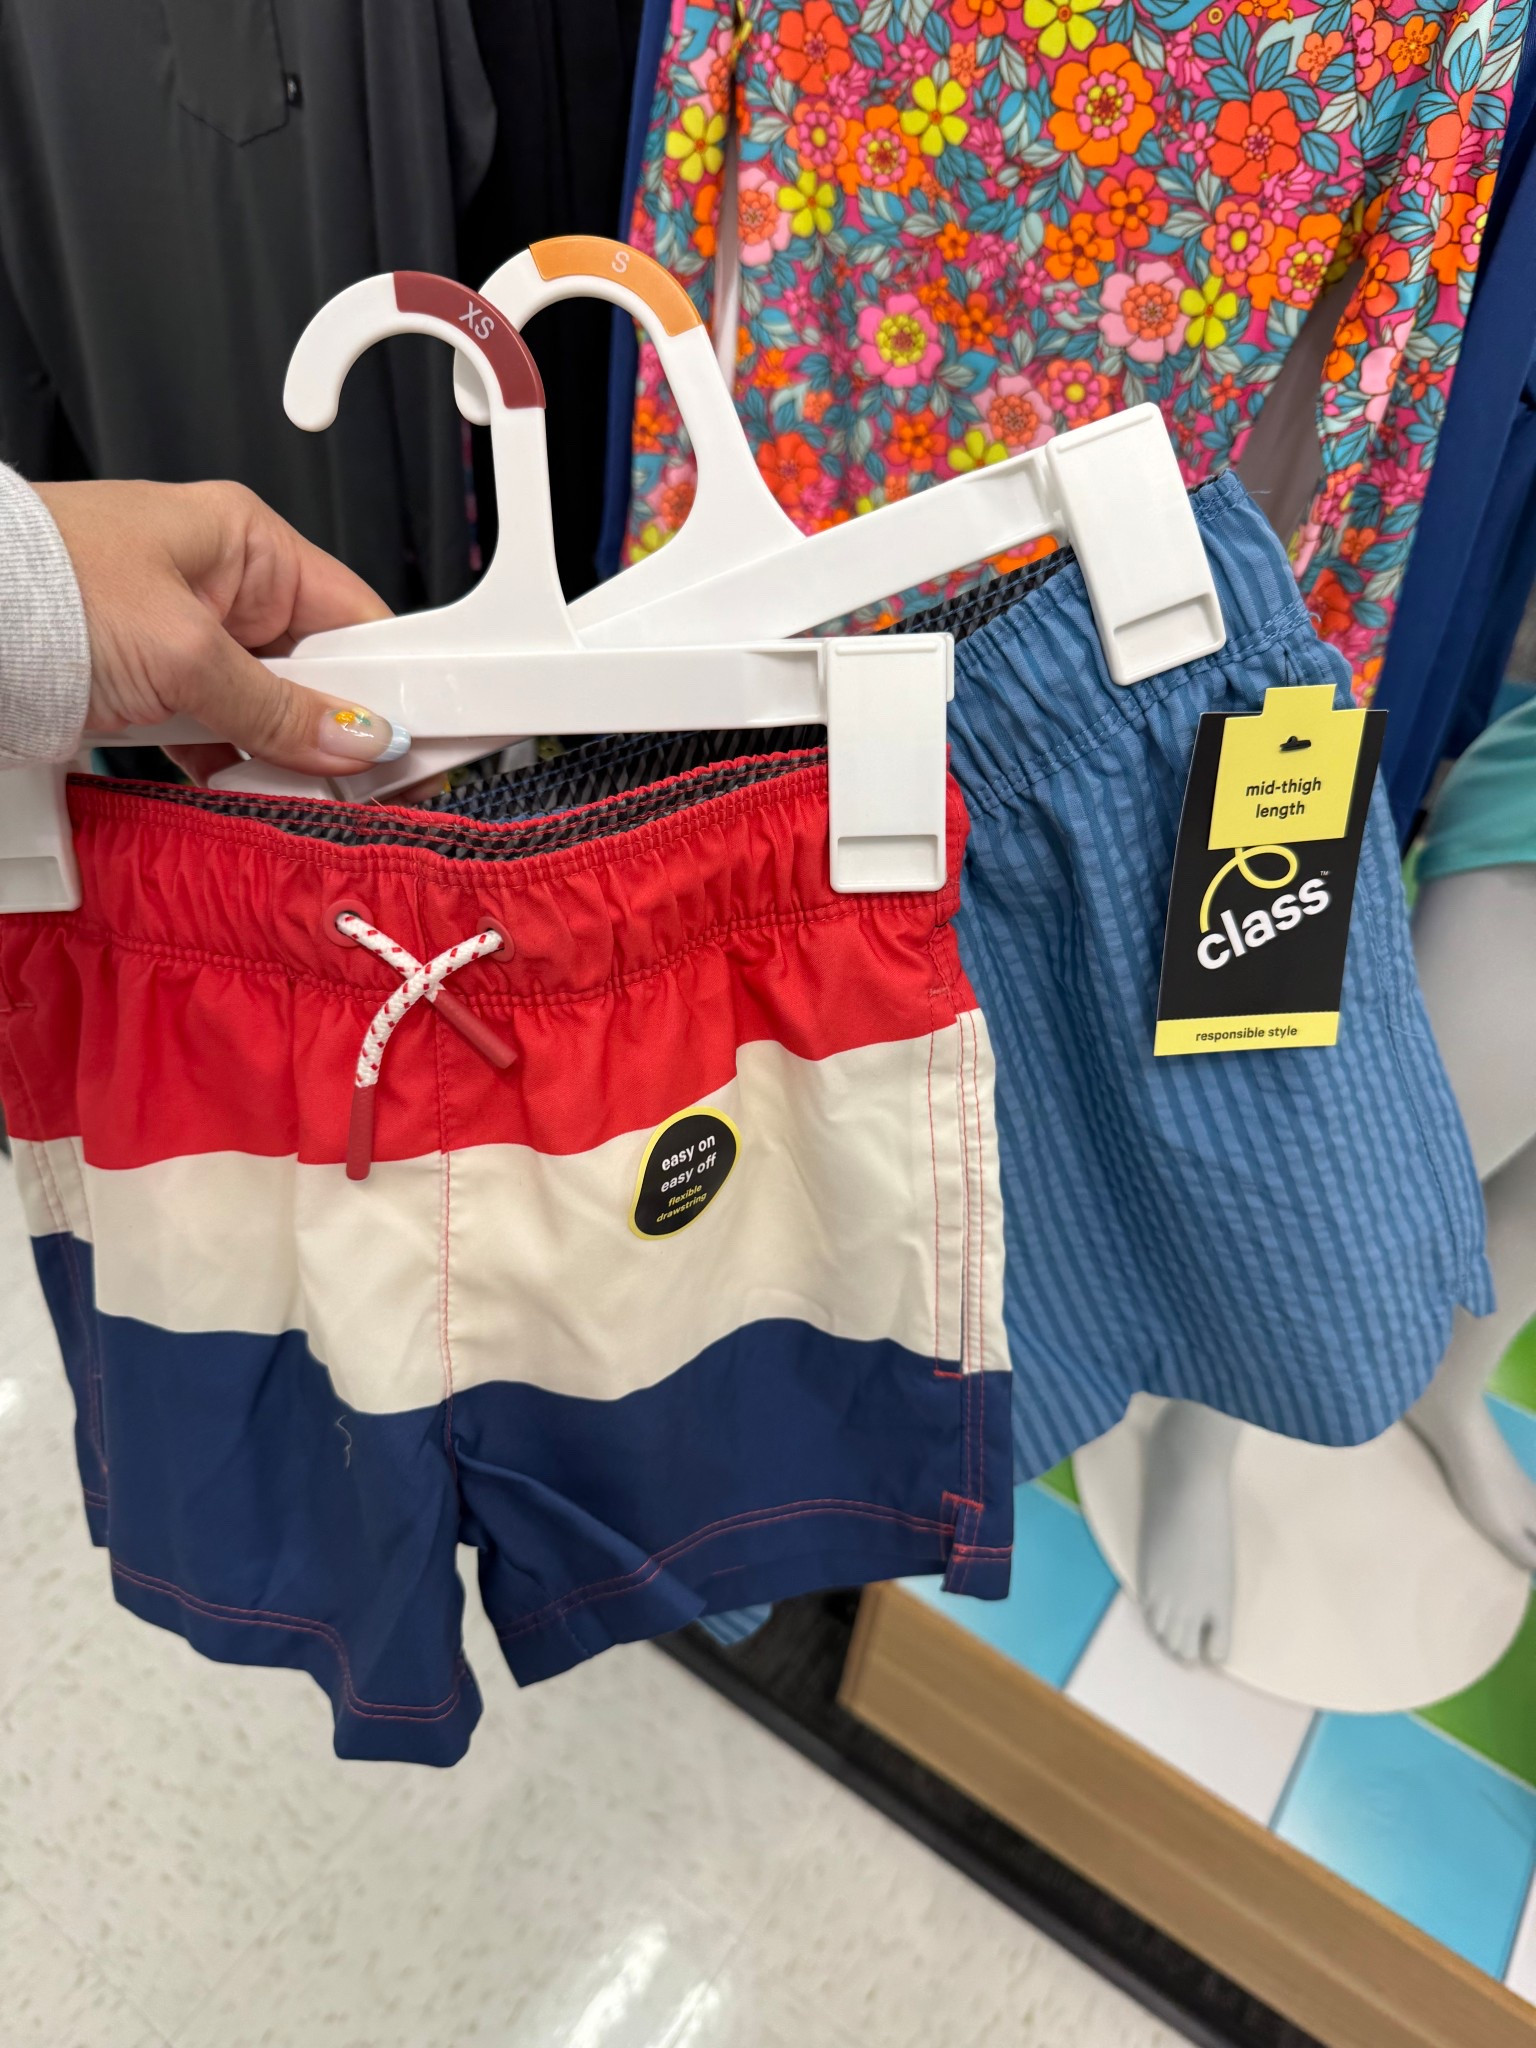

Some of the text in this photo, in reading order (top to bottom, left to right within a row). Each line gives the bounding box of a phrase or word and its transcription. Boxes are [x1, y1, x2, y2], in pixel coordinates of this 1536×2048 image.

[611, 251, 630, 273] S
[458, 300, 495, 340] XS
[1245, 776, 1322, 797] mid-thigh
[1255, 800, 1305, 820] length
[1196, 877, 1331, 970] class
[1195, 1025, 1298, 1043] responsible style
[661, 1135, 716, 1171] easy on
[660, 1151, 717, 1193] easy off
[656, 1192, 708, 1223] drawstring
[668, 1184, 703, 1207] flexible
